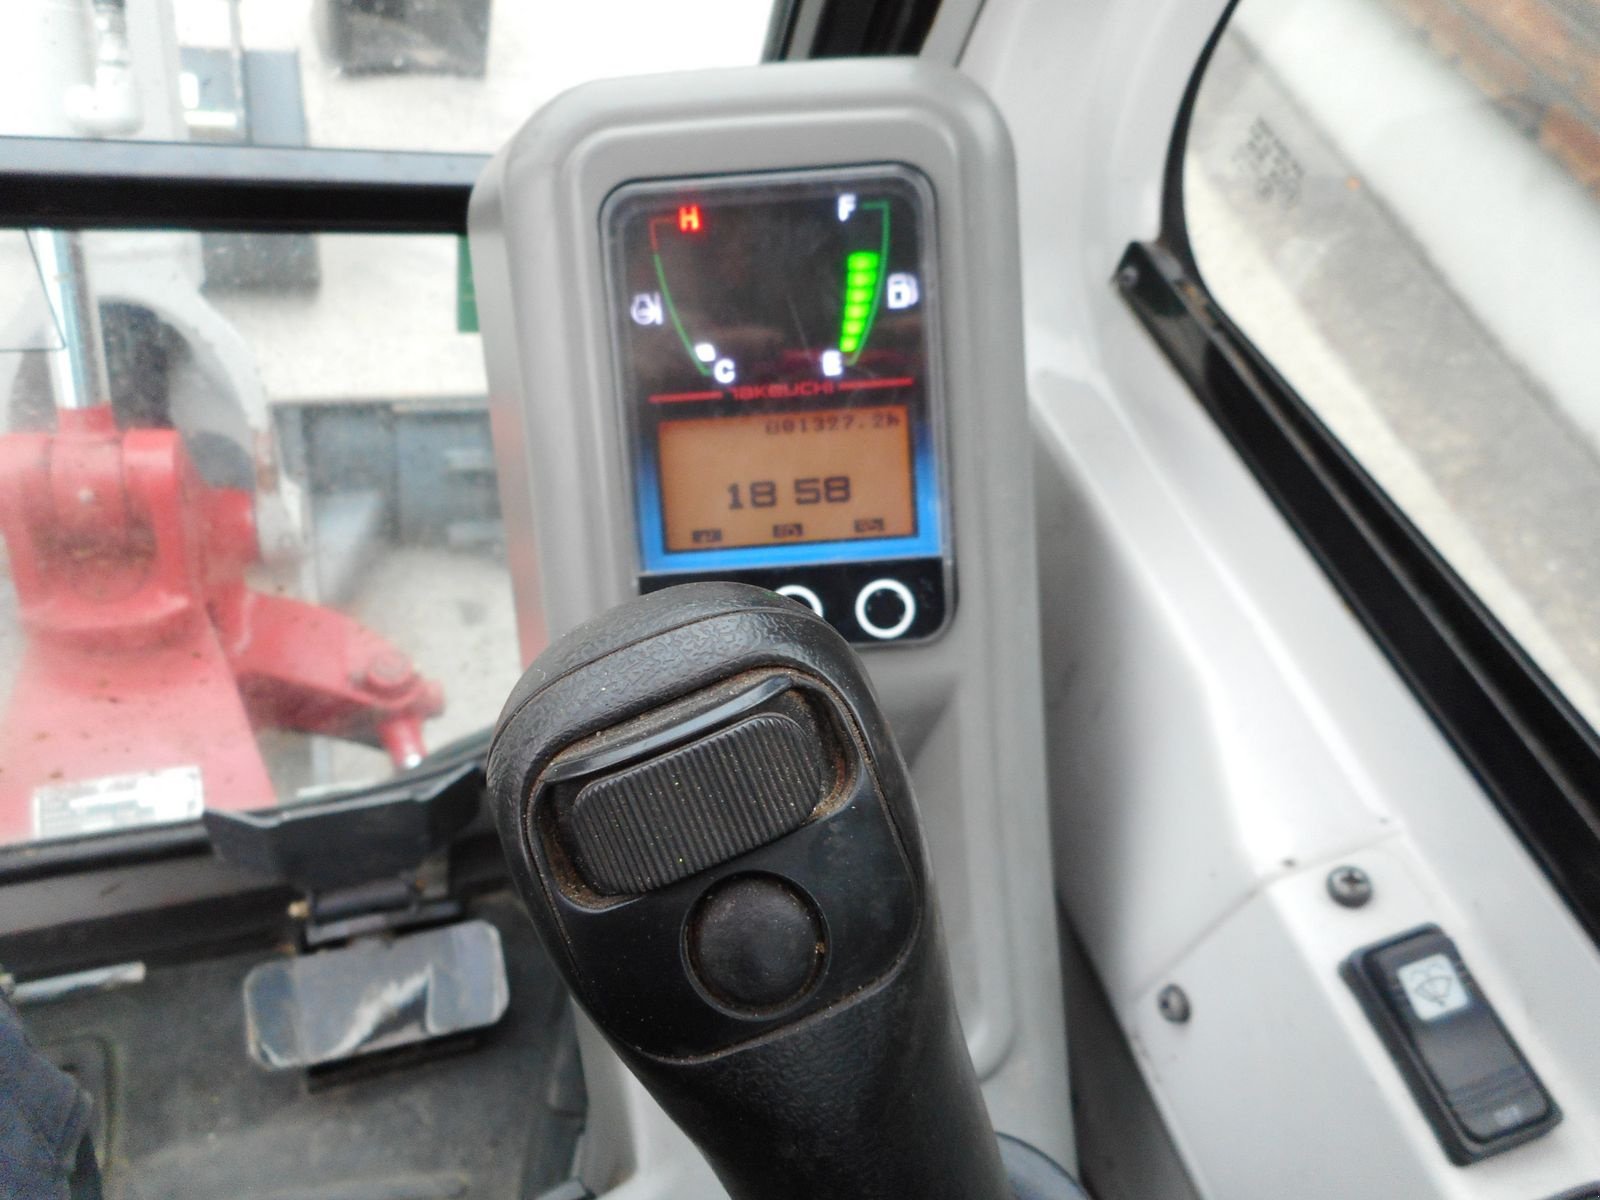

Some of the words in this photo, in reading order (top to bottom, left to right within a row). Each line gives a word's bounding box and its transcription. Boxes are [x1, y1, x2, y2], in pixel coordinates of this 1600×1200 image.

[678, 205, 701, 232] H
[837, 193, 856, 222] F
[713, 357, 736, 383] C
[821, 349, 842, 376] E
[727, 480, 777, 510] 18
[794, 476, 852, 505] 58
